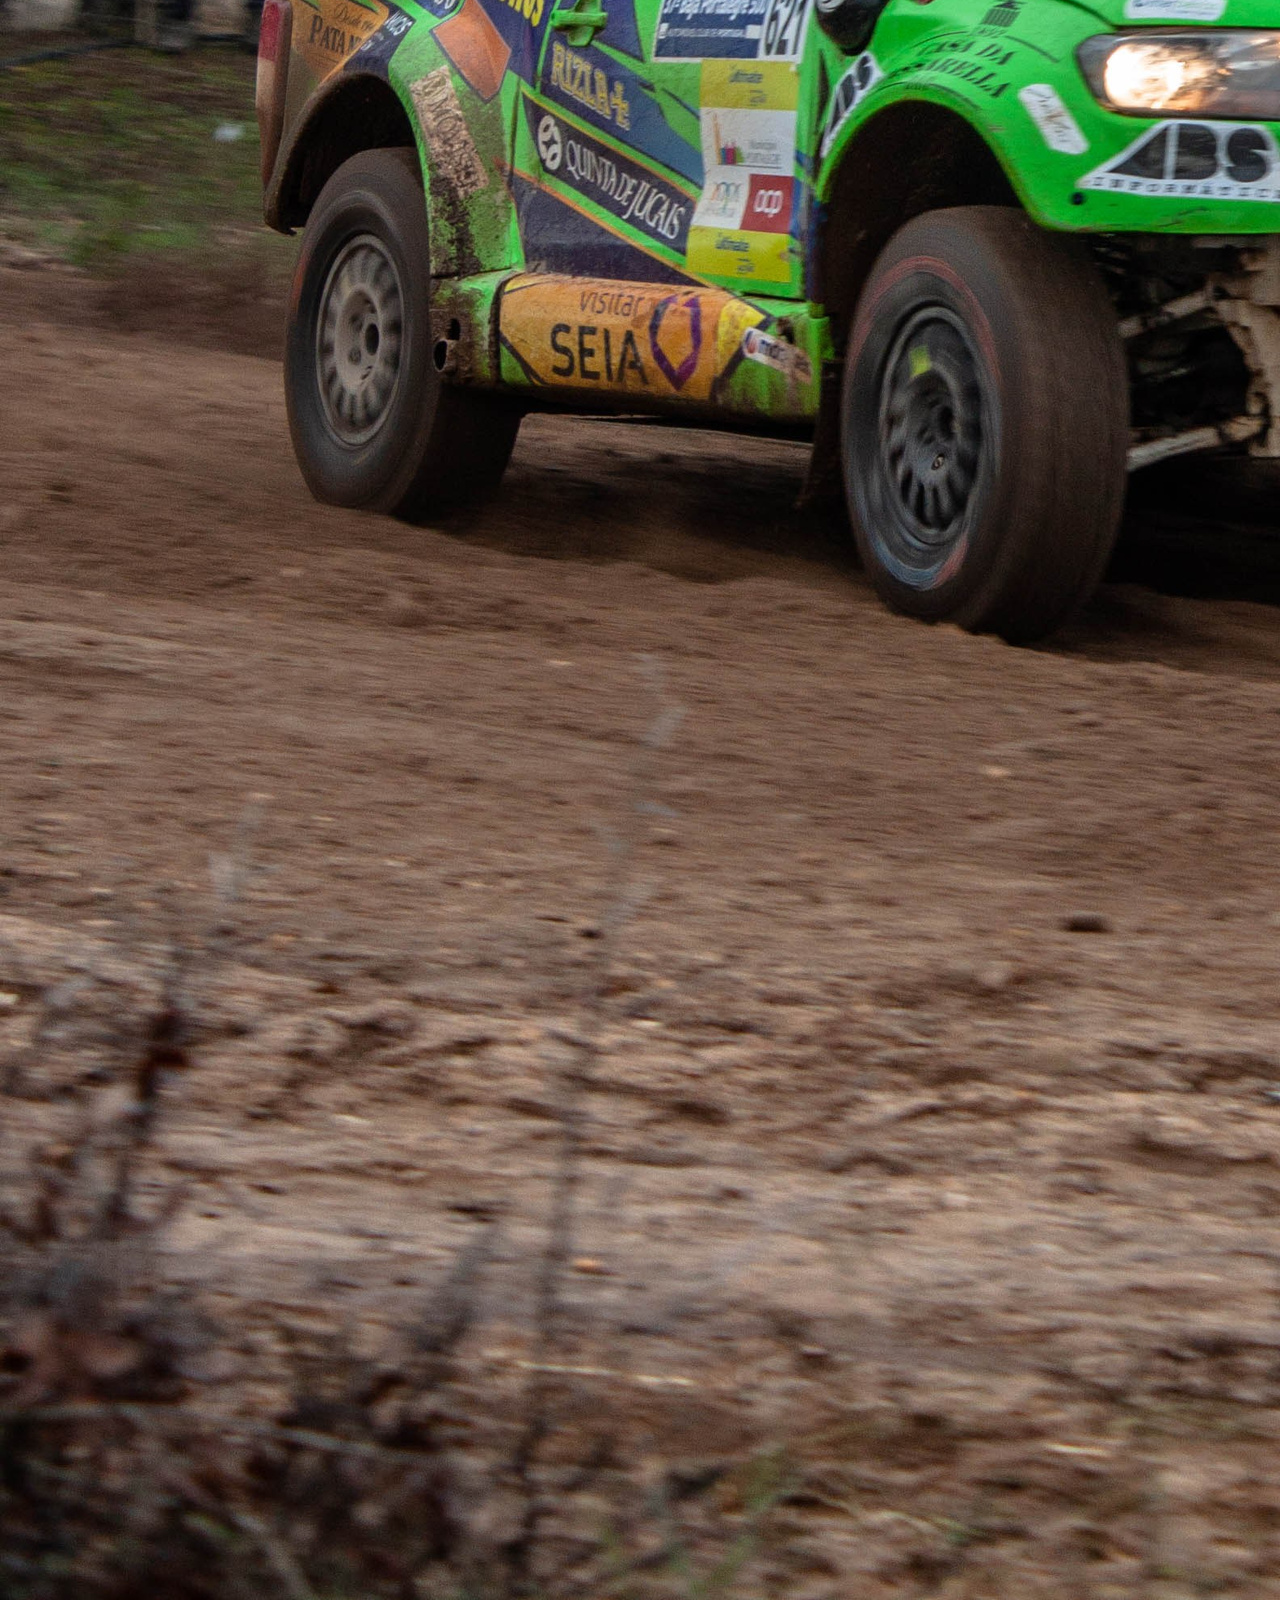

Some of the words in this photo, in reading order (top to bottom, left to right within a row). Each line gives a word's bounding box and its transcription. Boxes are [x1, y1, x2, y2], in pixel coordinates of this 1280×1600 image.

[565, 139, 618, 198] QUINTA
[614, 172, 638, 206] DE
[1104, 122, 1272, 183] ABS
[752, 188, 785, 219] acp
[580, 291, 645, 317] visitar
[550, 322, 649, 386] SEIA
